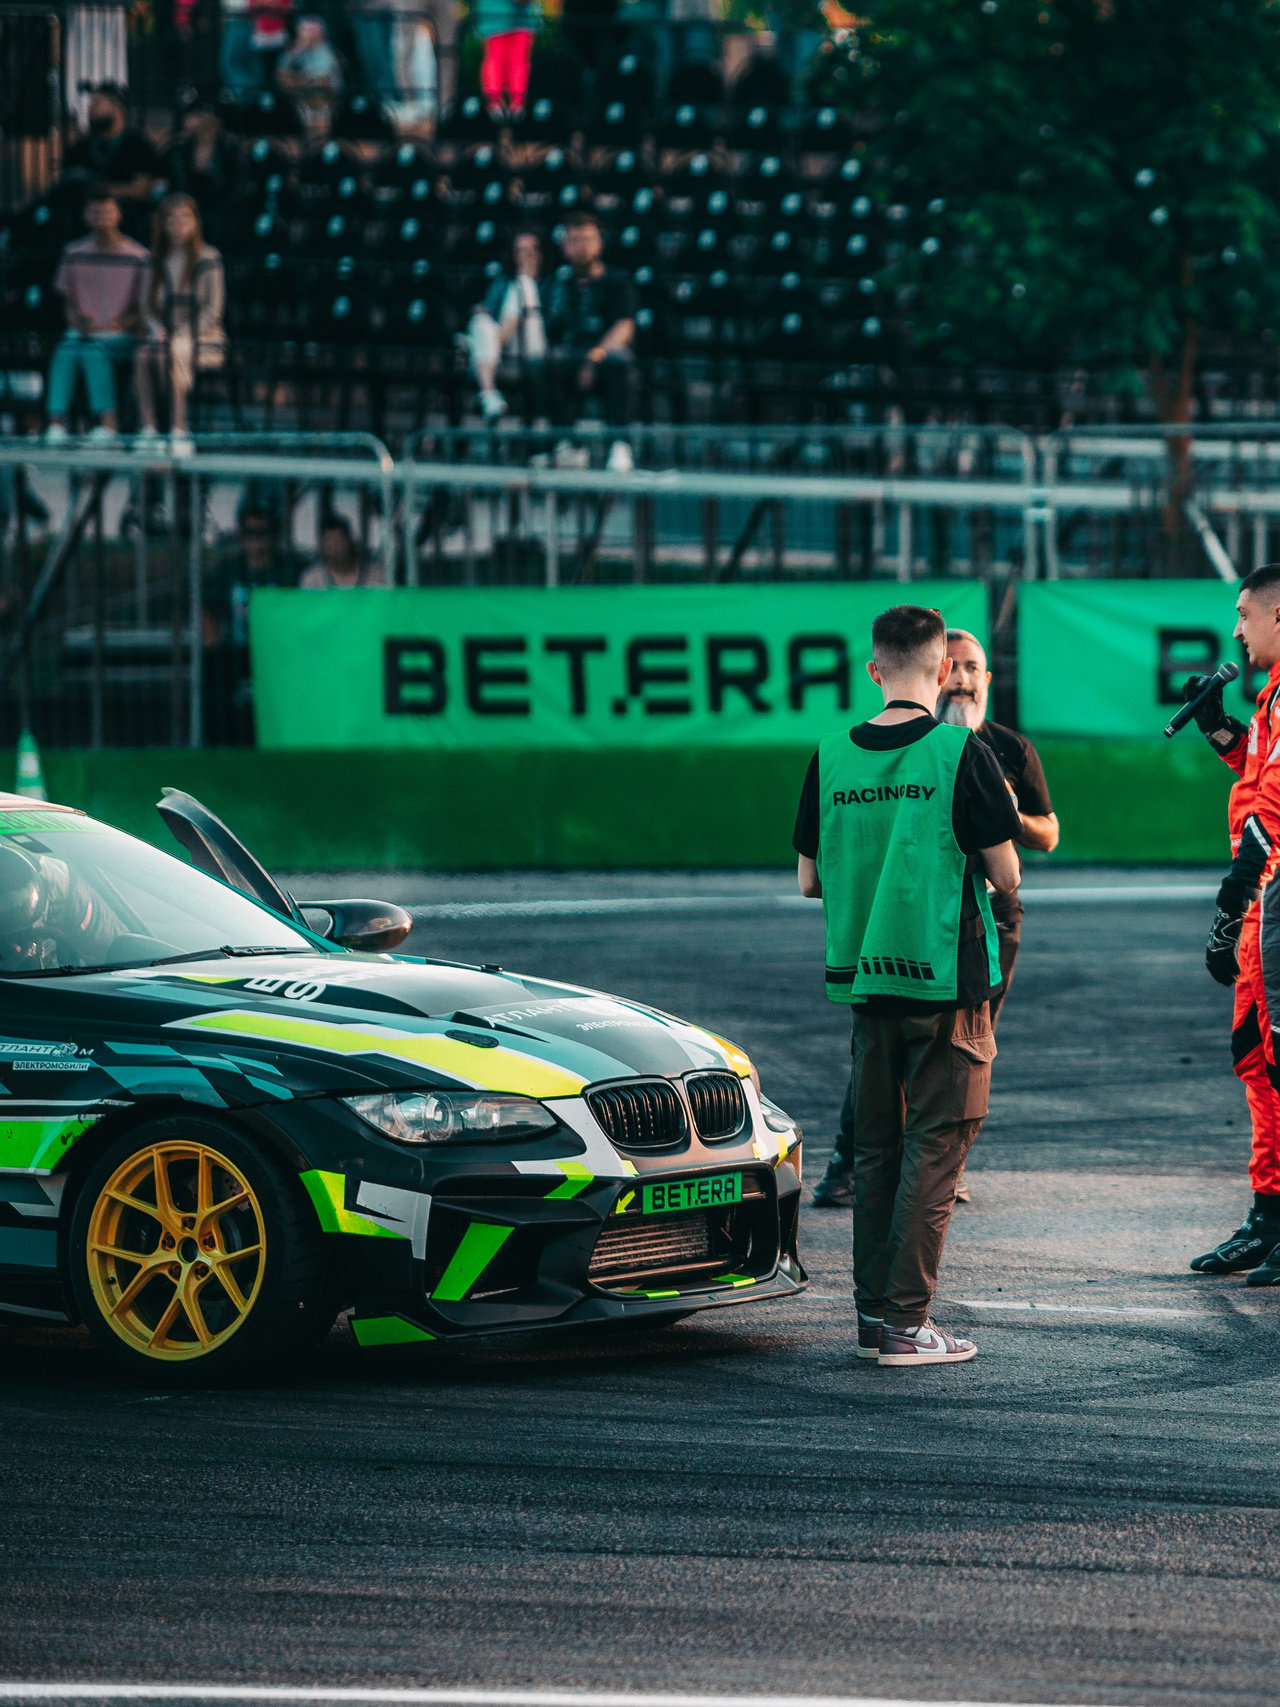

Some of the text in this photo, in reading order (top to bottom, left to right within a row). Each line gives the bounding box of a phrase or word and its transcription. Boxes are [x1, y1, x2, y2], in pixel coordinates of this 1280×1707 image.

[383, 631, 852, 717] BET.ERA
[0, 1044, 52, 1054] ТЛАНТ
[14, 1061, 88, 1070] ЭЛЕКТРОМОБИЛИ
[652, 1177, 735, 1210] BET.ERA
